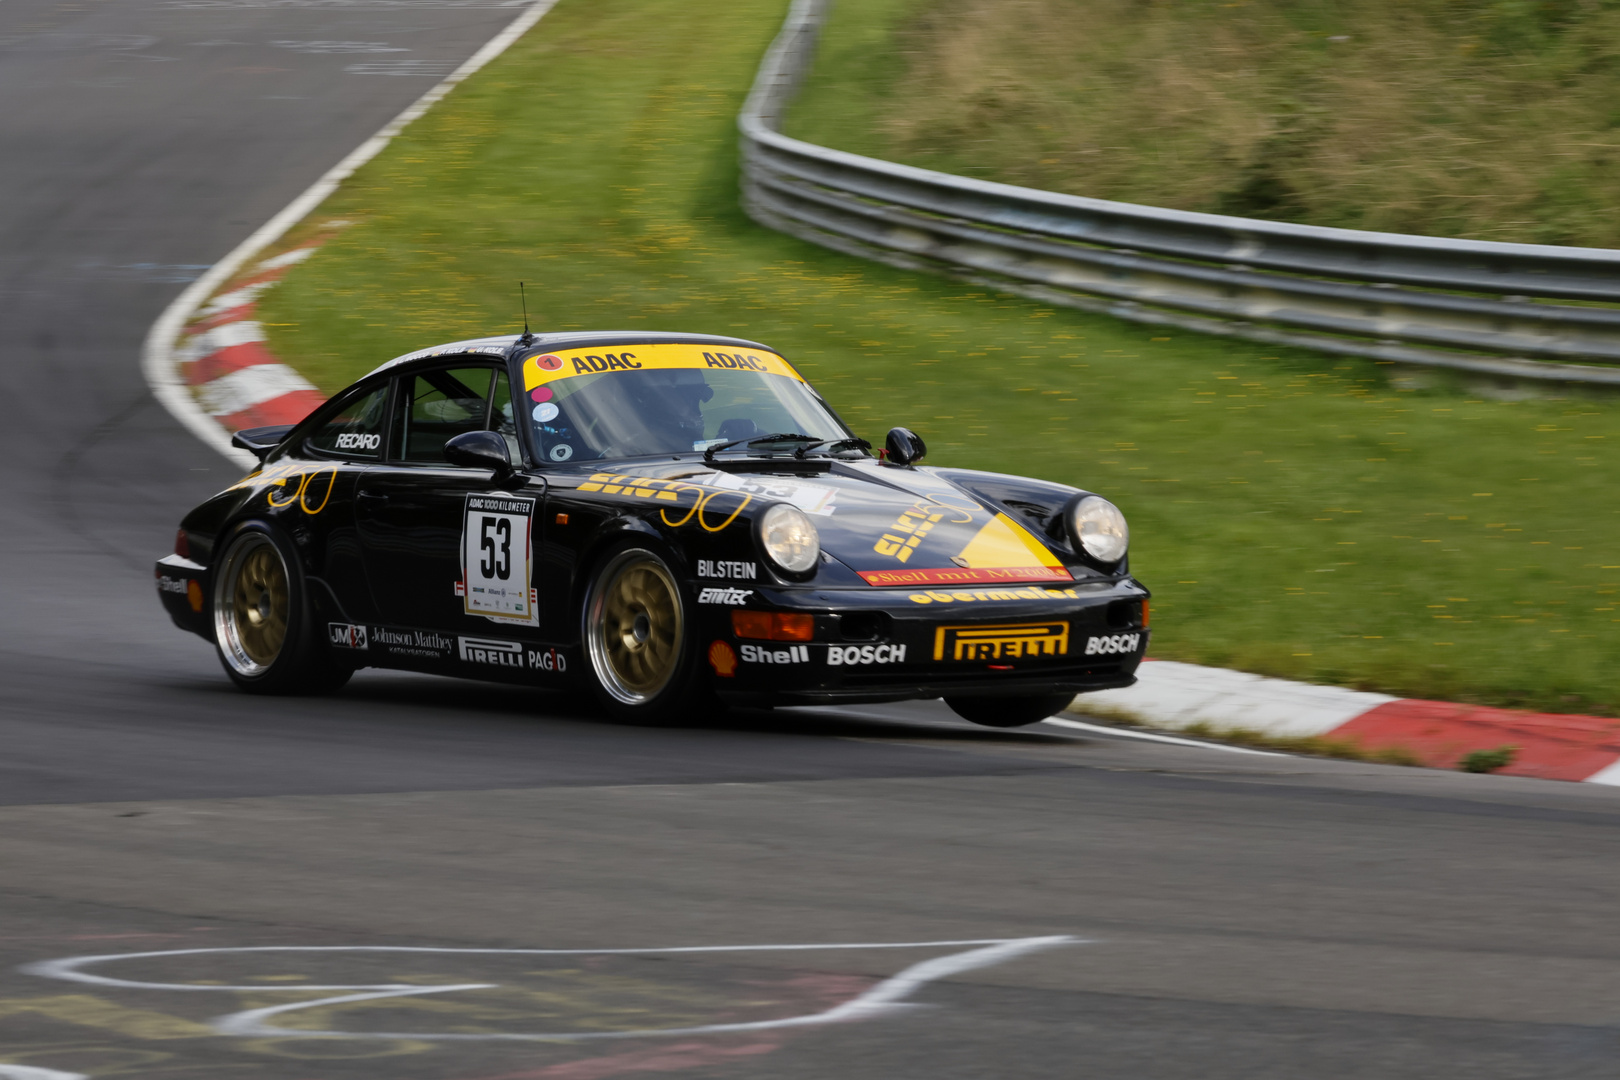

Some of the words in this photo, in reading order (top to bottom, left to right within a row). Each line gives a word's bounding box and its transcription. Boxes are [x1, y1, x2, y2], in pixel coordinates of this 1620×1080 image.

[544, 357, 555, 368] 1
[571, 352, 642, 374] ADAC
[702, 352, 768, 371] ADAC
[335, 433, 381, 450] RECARO
[741, 479, 799, 498] 53
[468, 498, 484, 508] ADAC
[484, 499, 499, 510] 1000
[499, 501, 531, 513] KILOMETER
[480, 516, 511, 581] 53
[697, 559, 757, 580] BILSTEIN
[877, 570, 931, 582] Shell
[935, 570, 981, 580] mit
[908, 586, 1080, 605] obermaier
[371, 626, 412, 646] Johnson
[414, 630, 453, 654] Matthey
[933, 620, 1070, 661] PIRELLI
[1084, 632, 1140, 655] BOSCH
[388, 646, 440, 659] KATALYSATOREN
[457, 636, 524, 668] PIRELLI
[740, 644, 810, 664] Shell
[827, 644, 907, 666] BOSCH
